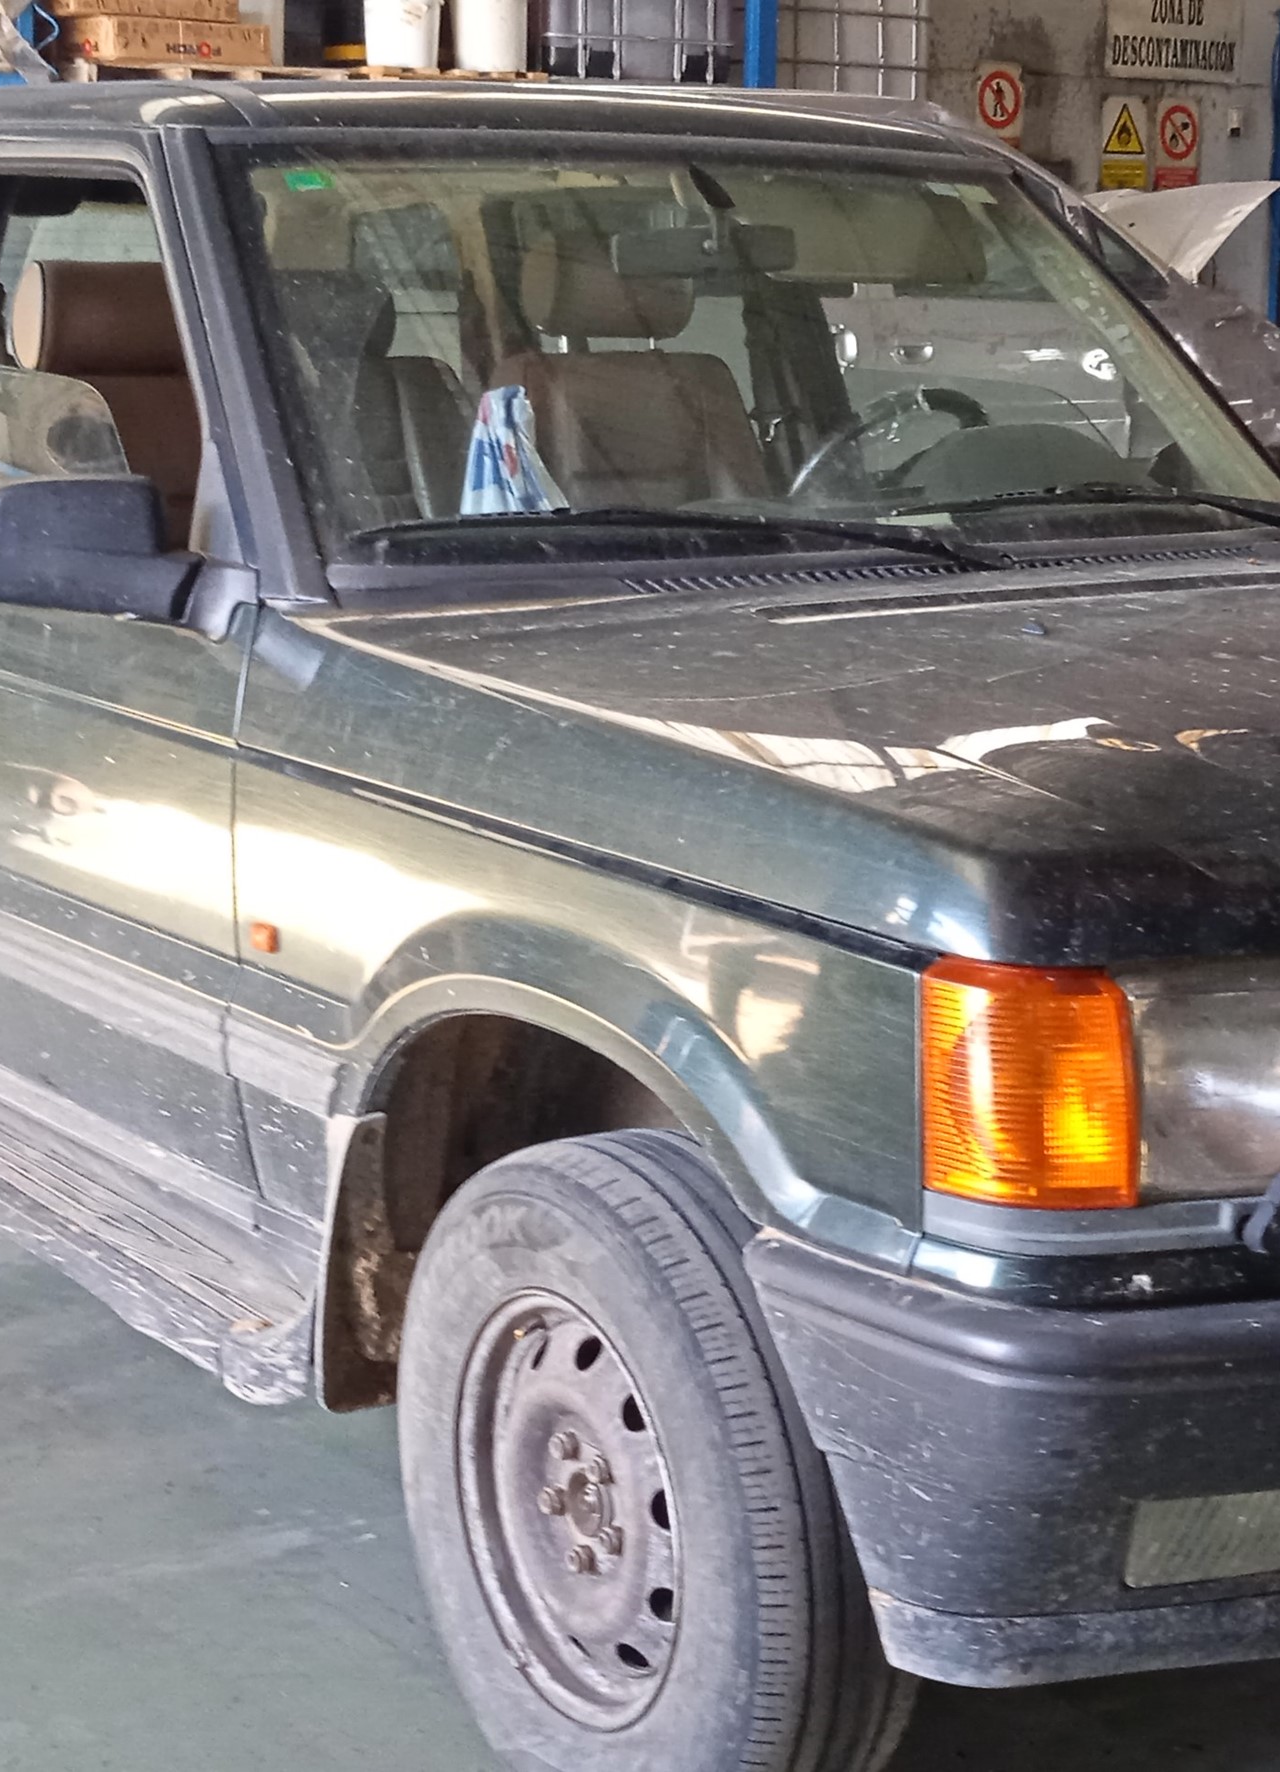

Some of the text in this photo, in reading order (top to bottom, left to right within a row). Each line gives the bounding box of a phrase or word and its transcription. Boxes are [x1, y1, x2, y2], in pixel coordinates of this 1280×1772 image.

[1151, 0, 1205, 26] ZONA DE
[1111, 31, 1237, 72] DESCONTAMINACIÓN
